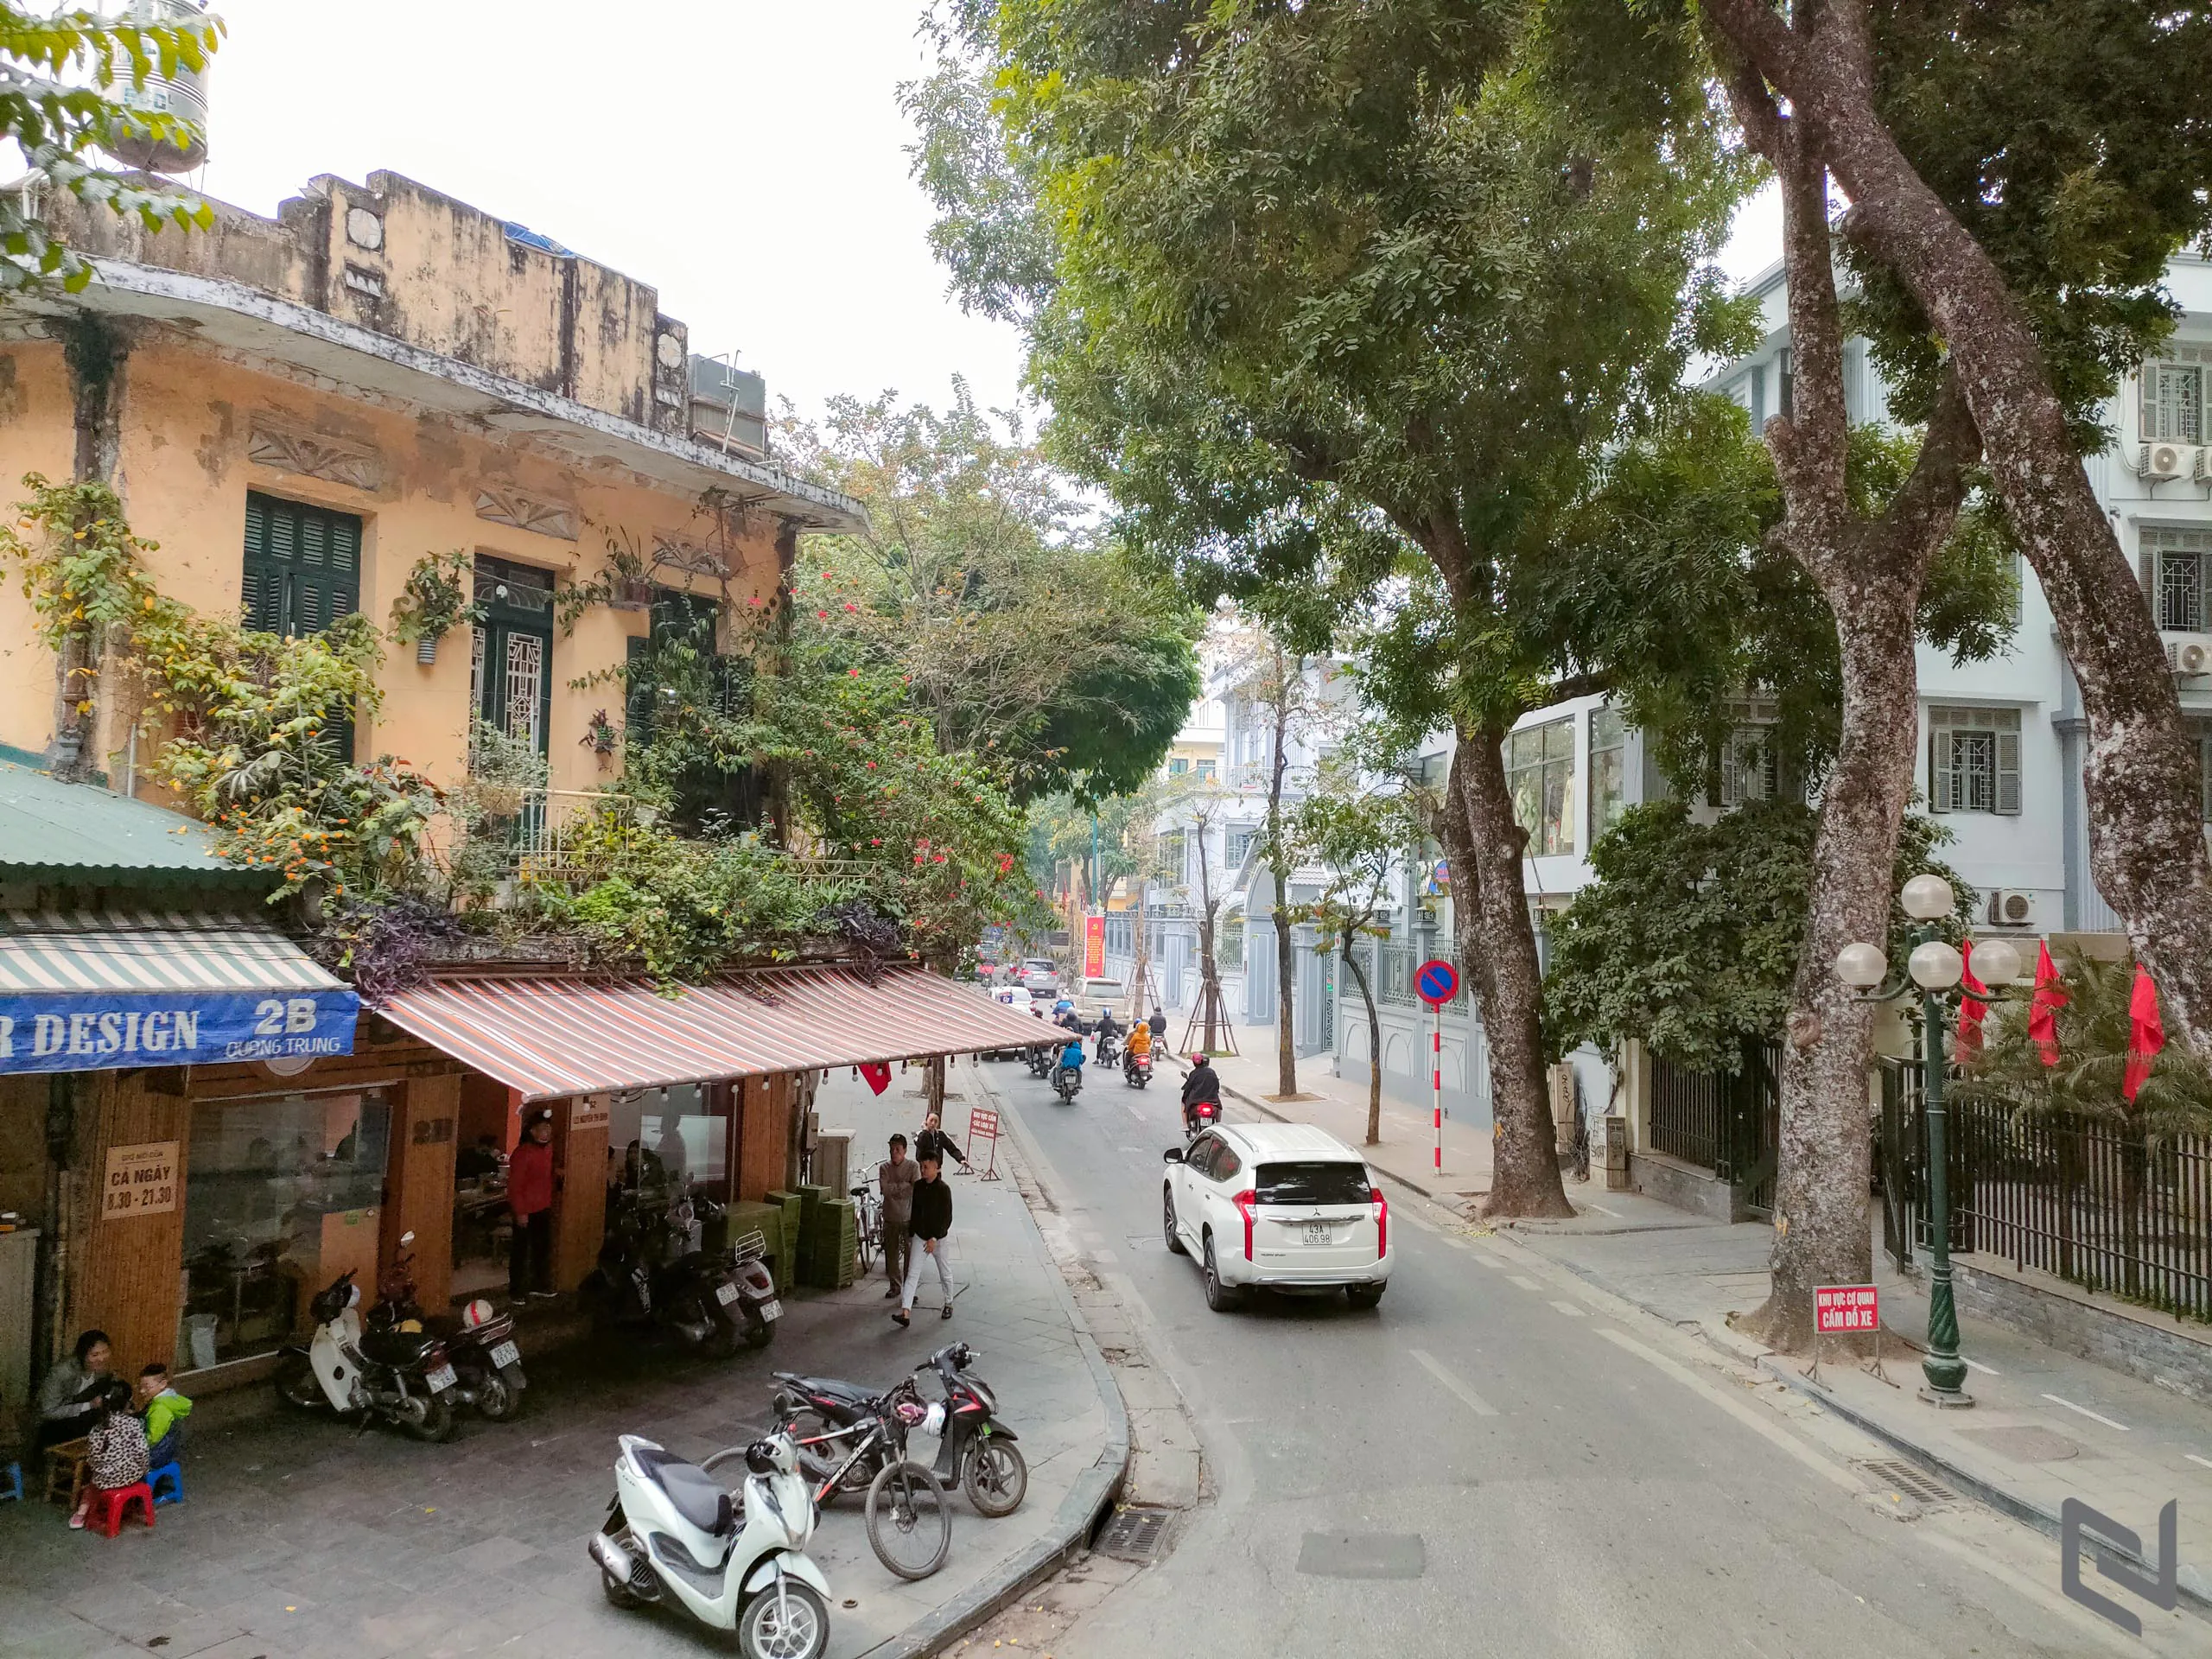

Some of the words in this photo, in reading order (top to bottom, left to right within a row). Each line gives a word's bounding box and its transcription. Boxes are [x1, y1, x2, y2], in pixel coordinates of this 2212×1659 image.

[254, 999, 316, 1034] 2B
[31, 1010, 200, 1056] DESIGN
[286, 1037, 340, 1053] TRUNG
[1309, 1224, 1324, 1234] 43A
[1304, 1235, 1330, 1244] 406.98
[1818, 1294, 1832, 1306] KHU
[1857, 1292, 1875, 1306] QUAN
[1860, 1311, 1872, 1326] XE
